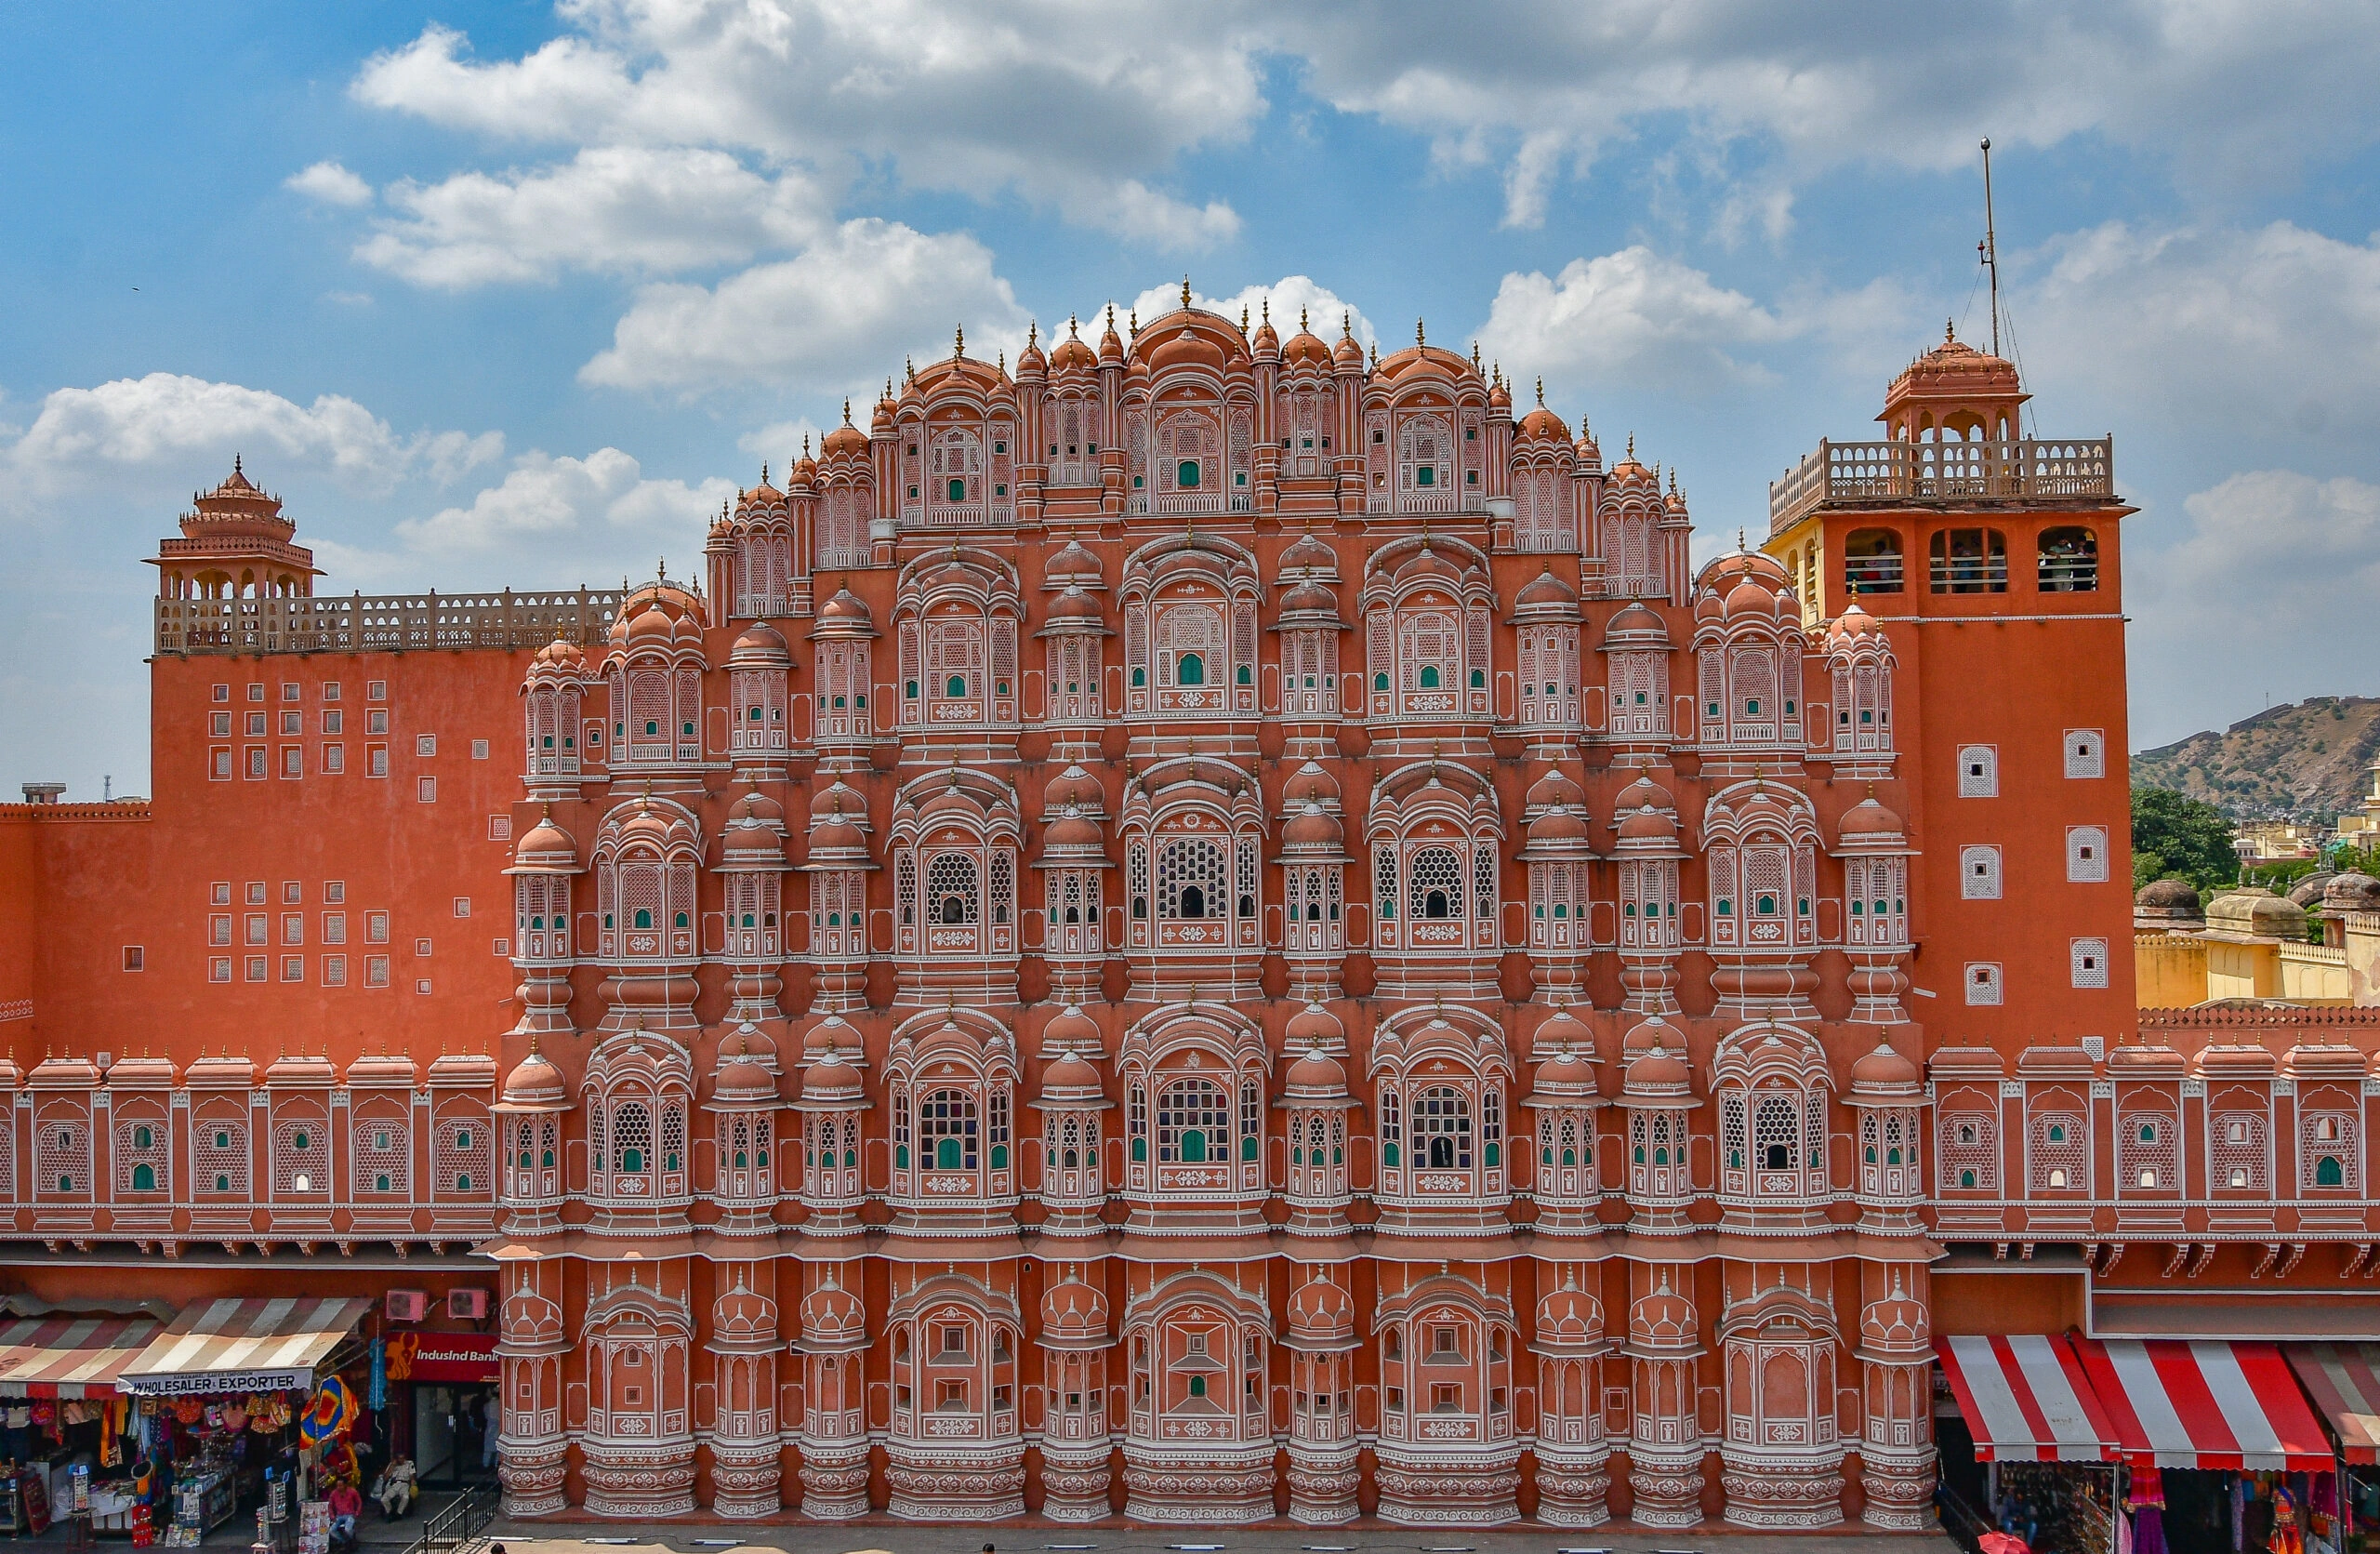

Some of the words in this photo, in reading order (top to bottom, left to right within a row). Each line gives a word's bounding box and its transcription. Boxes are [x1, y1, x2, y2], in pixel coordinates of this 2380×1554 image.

[417, 1349, 469, 1361] IndusInd
[469, 1351, 499, 1361] Bank
[133, 1378, 211, 1393] WHOLESALER
[218, 1375, 295, 1388] EXPORTER
